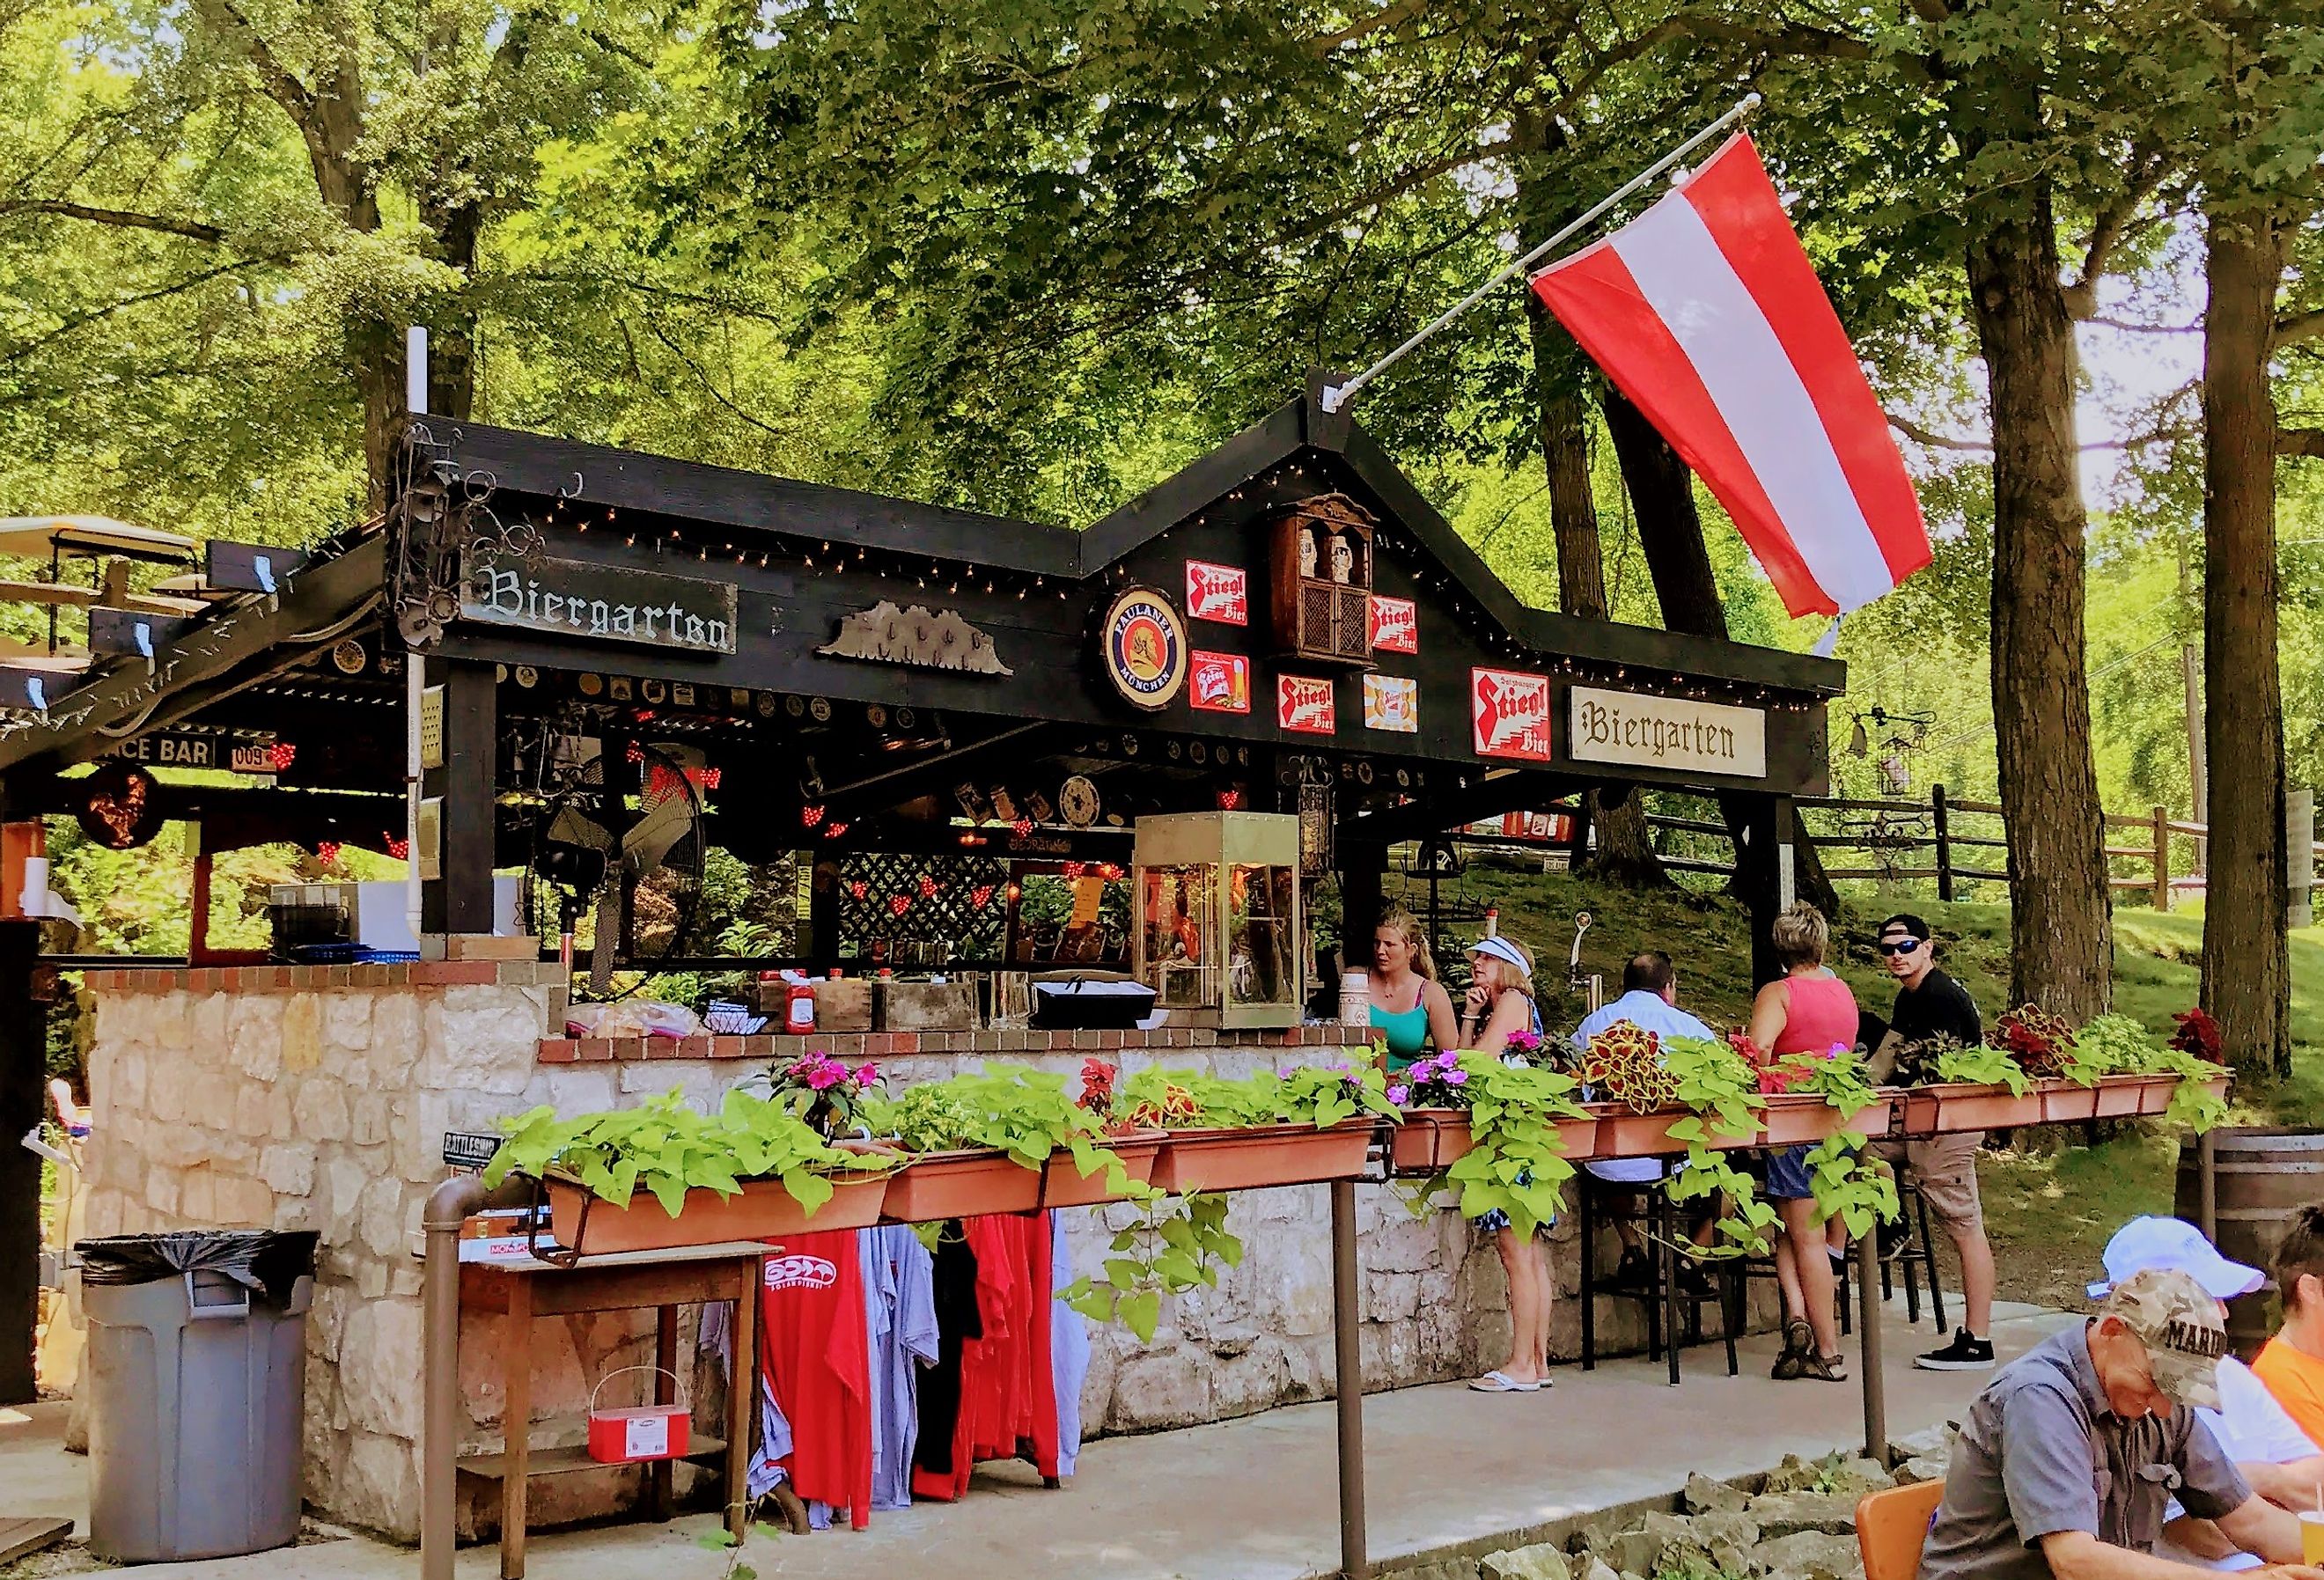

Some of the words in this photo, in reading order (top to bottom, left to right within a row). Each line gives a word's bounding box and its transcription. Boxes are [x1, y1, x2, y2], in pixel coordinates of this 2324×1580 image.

[1189, 565, 1243, 614] Stiegl
[476, 566, 731, 650] Biergarten
[1223, 604, 1246, 621] Bier
[1114, 605, 1173, 640] PAULANER
[1395, 634, 1416, 650] Bier
[1282, 678, 1331, 725] Stiegl
[1477, 674, 1545, 749] Stiegl
[1312, 714, 1334, 730] Bier
[1581, 701, 1735, 759] Biergarten
[160, 739, 209, 764] BAR
[1520, 731, 1549, 754] Bier
[236, 748, 262, 765] 009
[445, 1134, 495, 1158] BATTLESHIP
